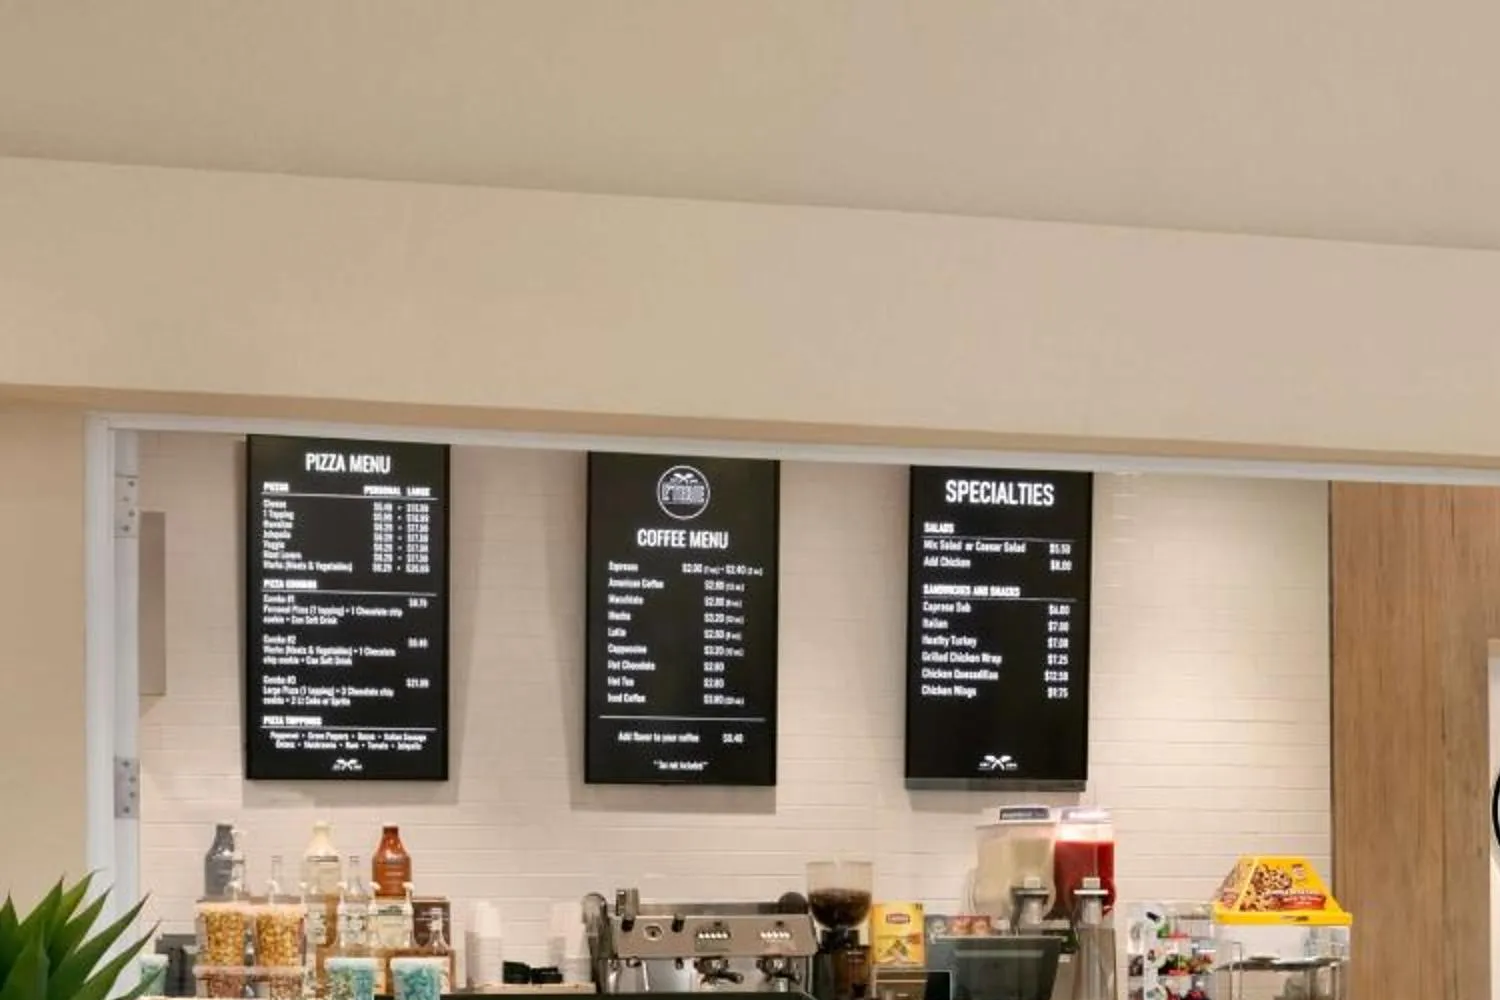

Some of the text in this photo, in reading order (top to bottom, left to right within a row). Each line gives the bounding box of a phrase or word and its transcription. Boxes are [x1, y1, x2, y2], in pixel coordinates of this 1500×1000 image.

[305, 453, 391, 474] PIZZA MENU
[945, 480, 1054, 506] SPECIALTIES
[924, 522, 954, 533] SALADS
[637, 529, 729, 549] COFFEE MENU
[940, 540, 962, 551] Salad
[1004, 541, 1026, 553] Salad
[923, 556, 970, 567] Add Chicken
[951, 636, 977, 649] Turkey
[950, 653, 980, 663] Chicken
[921, 668, 952, 679] Chicken
[921, 685, 952, 696] Chicken
